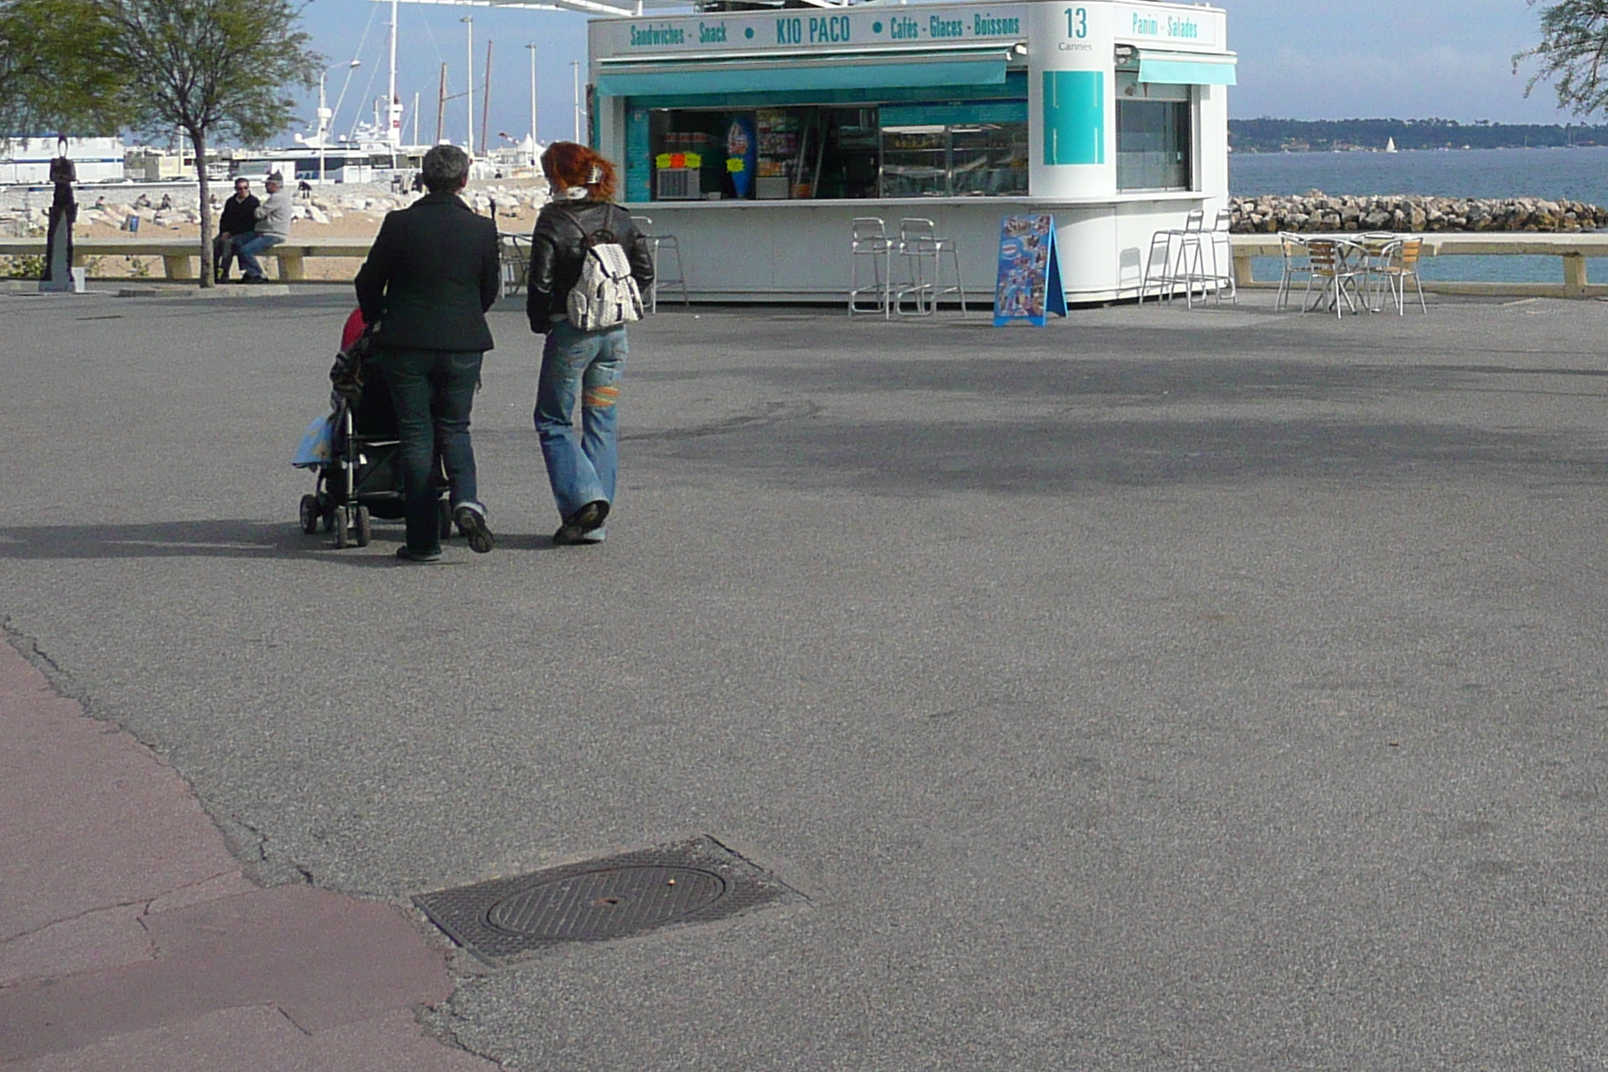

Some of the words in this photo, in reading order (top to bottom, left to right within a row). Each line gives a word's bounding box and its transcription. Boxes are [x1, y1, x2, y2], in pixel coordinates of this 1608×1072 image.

[630, 24, 684, 46] Sandwiches
[699, 21, 727, 43] Snack
[776, 18, 801, 44] KIO
[809, 15, 850, 43] PACO
[929, 15, 963, 38] Glaces
[974, 13, 1019, 36] Boissons
[1064, 7, 1087, 39] 13
[1132, 12, 1158, 35] Panini
[1167, 15, 1198, 38] Salades
[1058, 42, 1092, 51] Cannes
